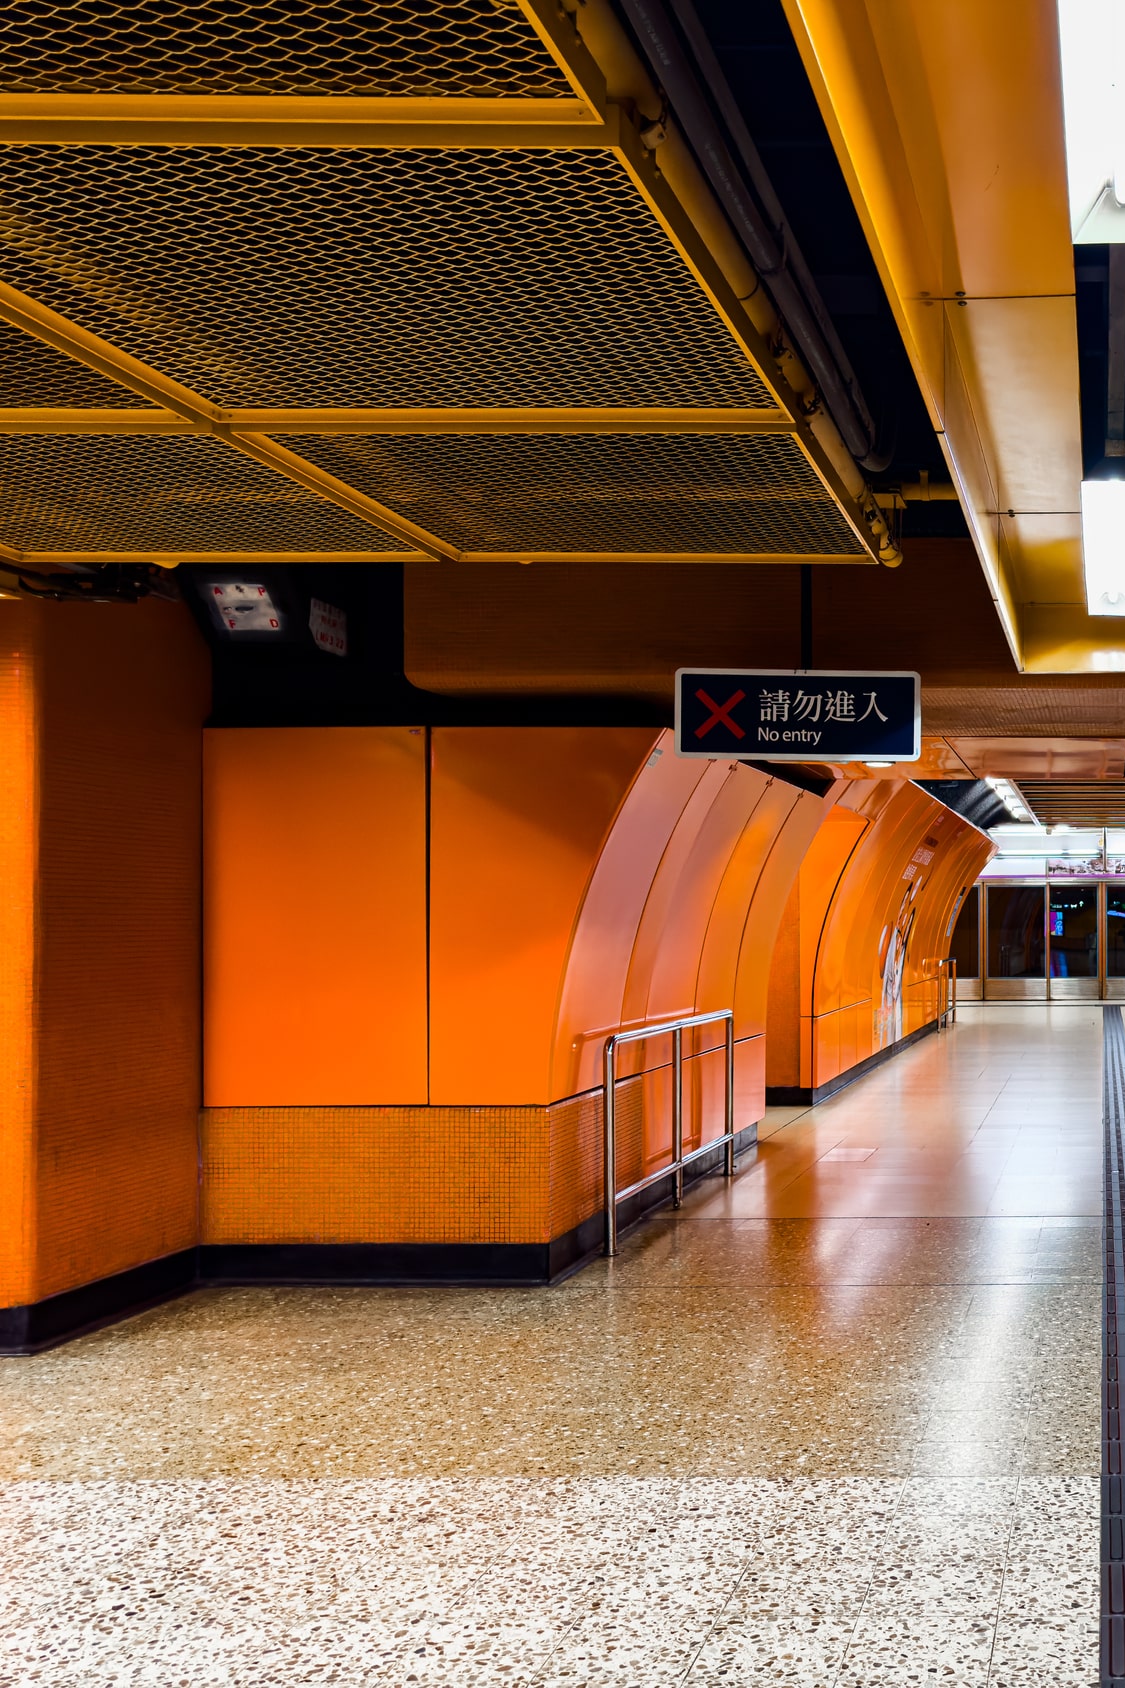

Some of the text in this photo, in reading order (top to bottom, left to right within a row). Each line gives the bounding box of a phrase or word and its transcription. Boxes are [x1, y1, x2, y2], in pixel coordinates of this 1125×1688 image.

[214, 587, 266, 596] A P
[270, 619, 279, 628] D
[758, 689, 889, 722] 請勿進入
[757, 727, 822, 746] No entry
